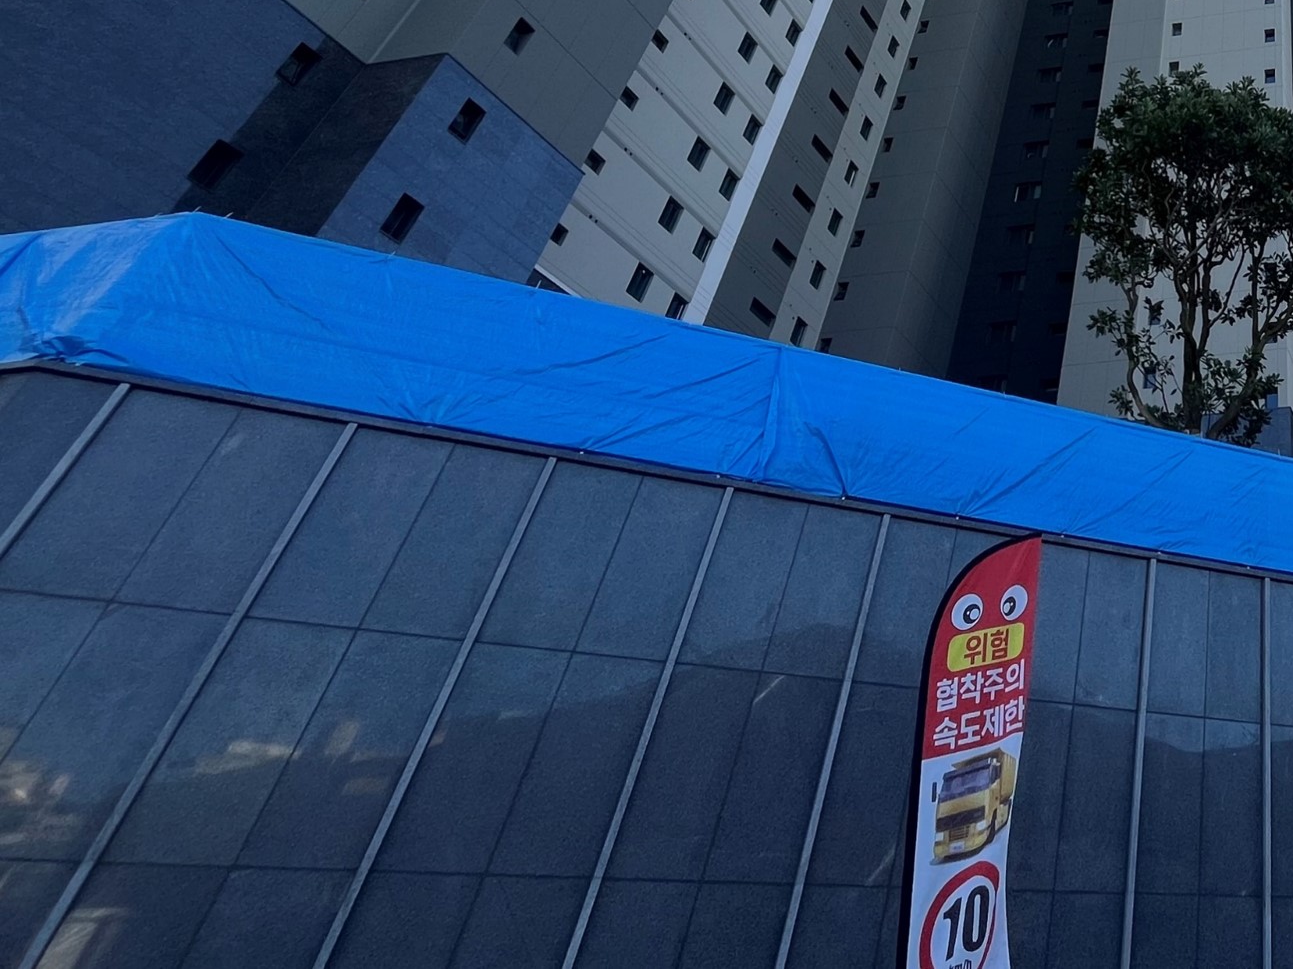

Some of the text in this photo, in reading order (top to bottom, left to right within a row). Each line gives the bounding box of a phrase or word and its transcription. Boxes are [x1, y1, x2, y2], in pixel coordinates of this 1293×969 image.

[964, 628, 1010, 665] 위험
[936, 658, 1025, 712] 협착주의
[932, 695, 1025, 749] 속도제한
[943, 885, 990, 962] 10
